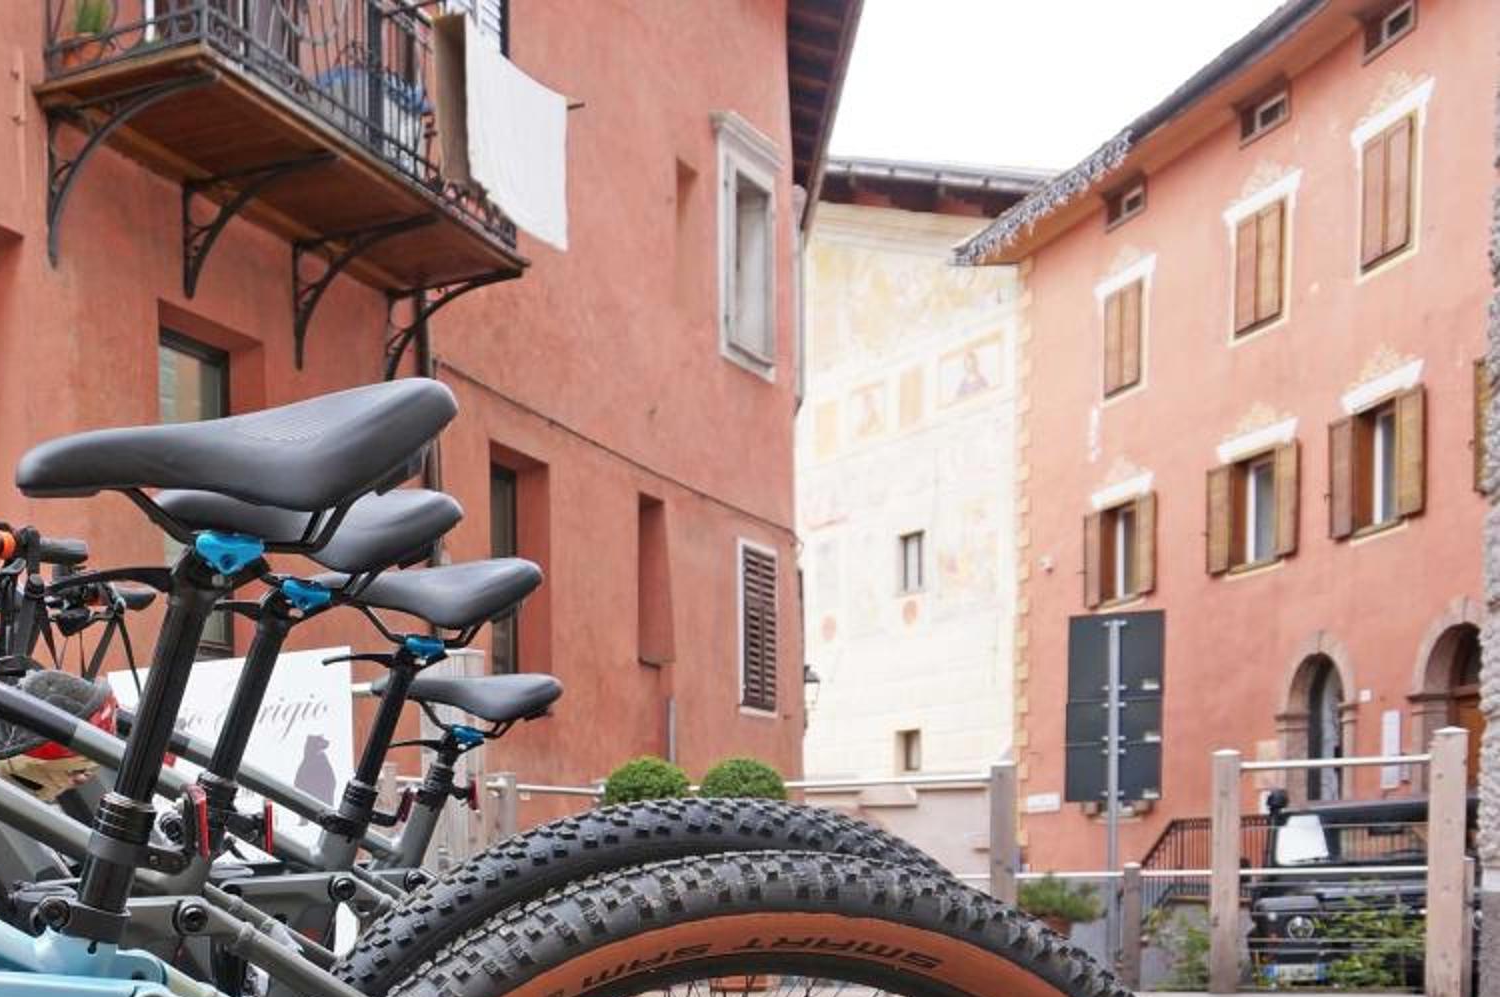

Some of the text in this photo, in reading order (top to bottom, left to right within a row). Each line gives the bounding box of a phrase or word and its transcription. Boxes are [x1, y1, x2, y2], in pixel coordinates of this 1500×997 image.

[214, 691, 328, 743] rigio
[581, 936, 944, 988] SMART SAM
